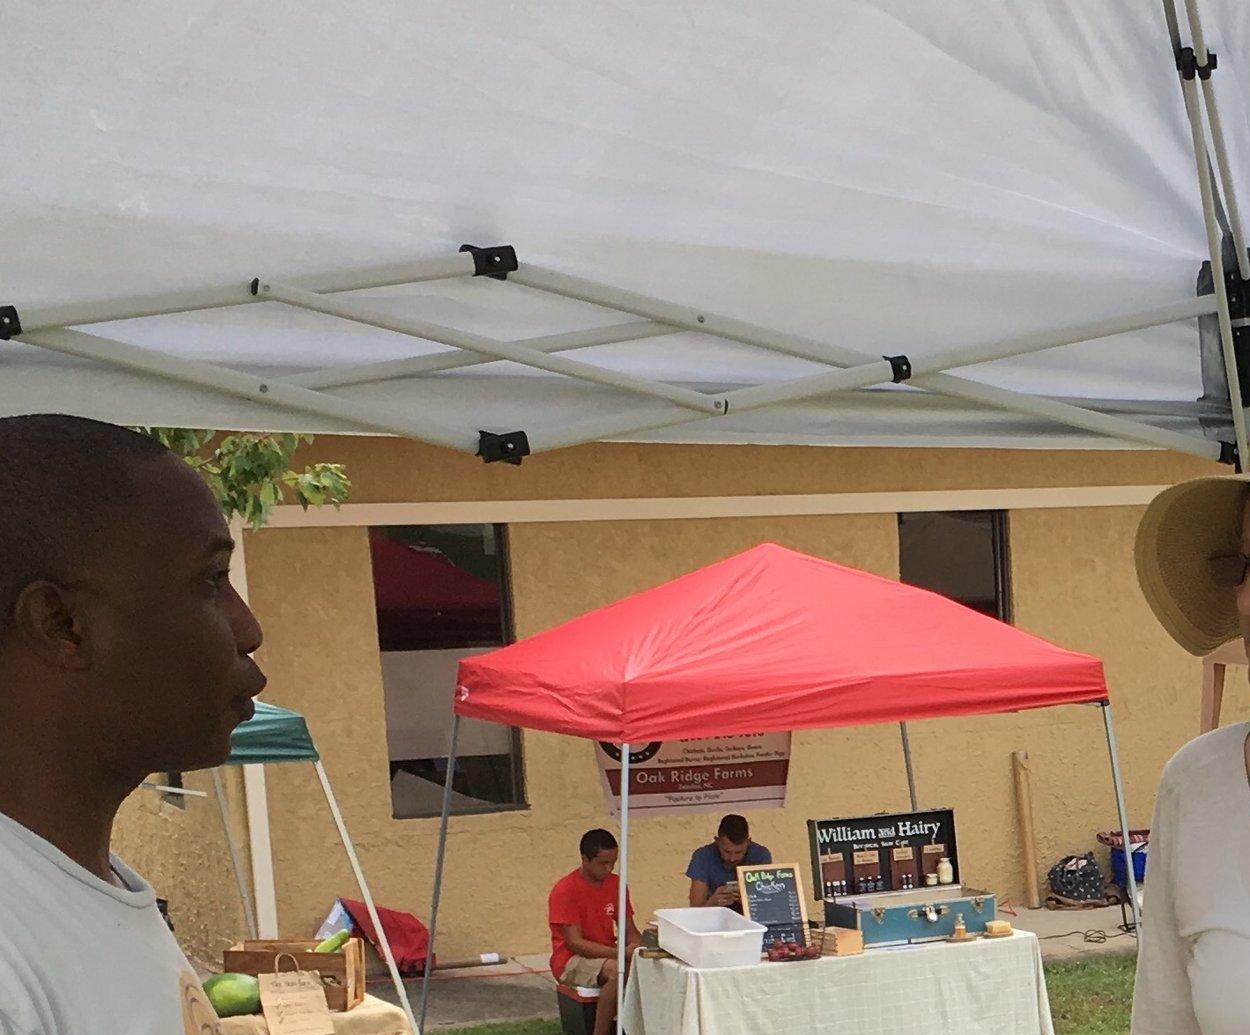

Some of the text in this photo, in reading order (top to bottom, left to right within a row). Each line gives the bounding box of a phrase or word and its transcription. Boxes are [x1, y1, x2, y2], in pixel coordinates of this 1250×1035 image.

[636, 767, 753, 784] Oak Ridge Farms
[817, 826, 877, 844] William
[897, 820, 941, 839] Hairy
